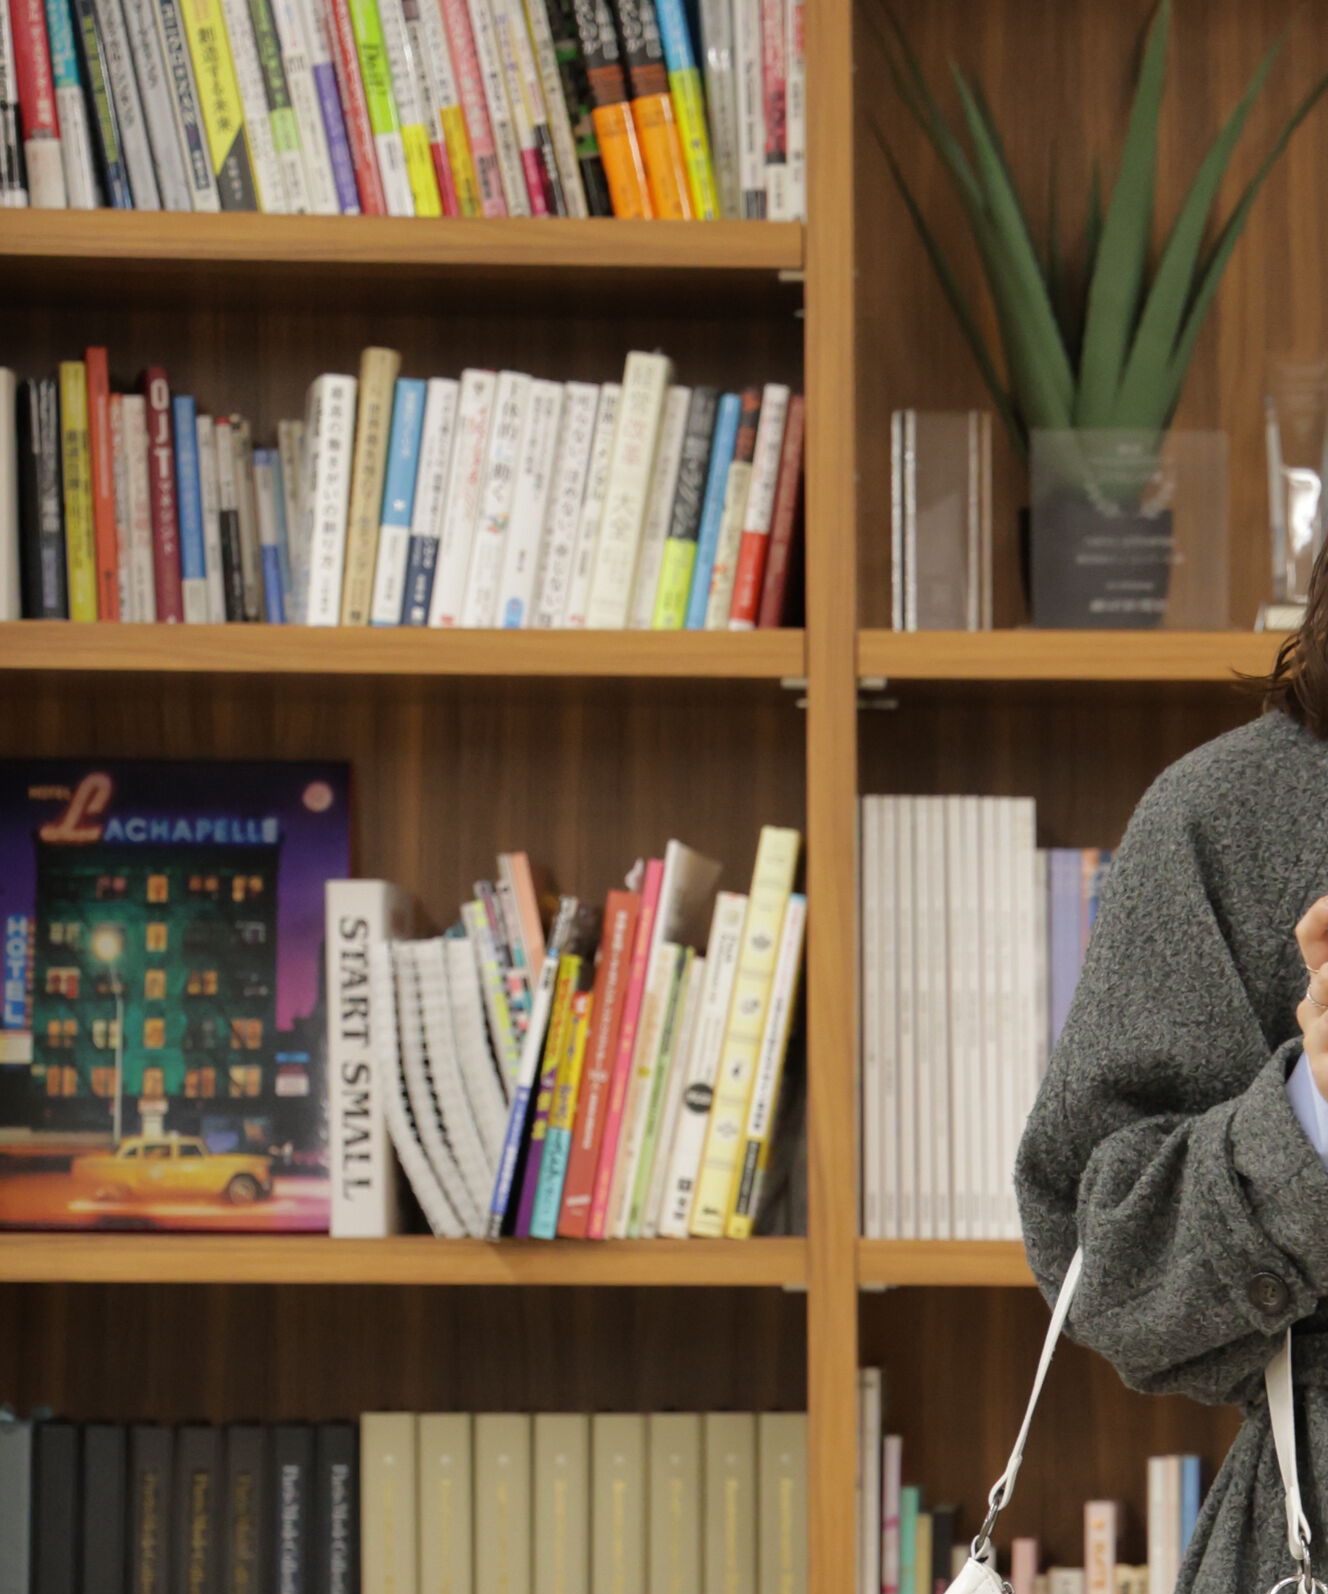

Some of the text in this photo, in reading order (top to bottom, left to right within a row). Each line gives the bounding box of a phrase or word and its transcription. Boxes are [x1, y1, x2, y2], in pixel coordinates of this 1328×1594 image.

[4, 914, 29, 1030] HOTEL
[338, 916, 373, 1201] START SMALL
